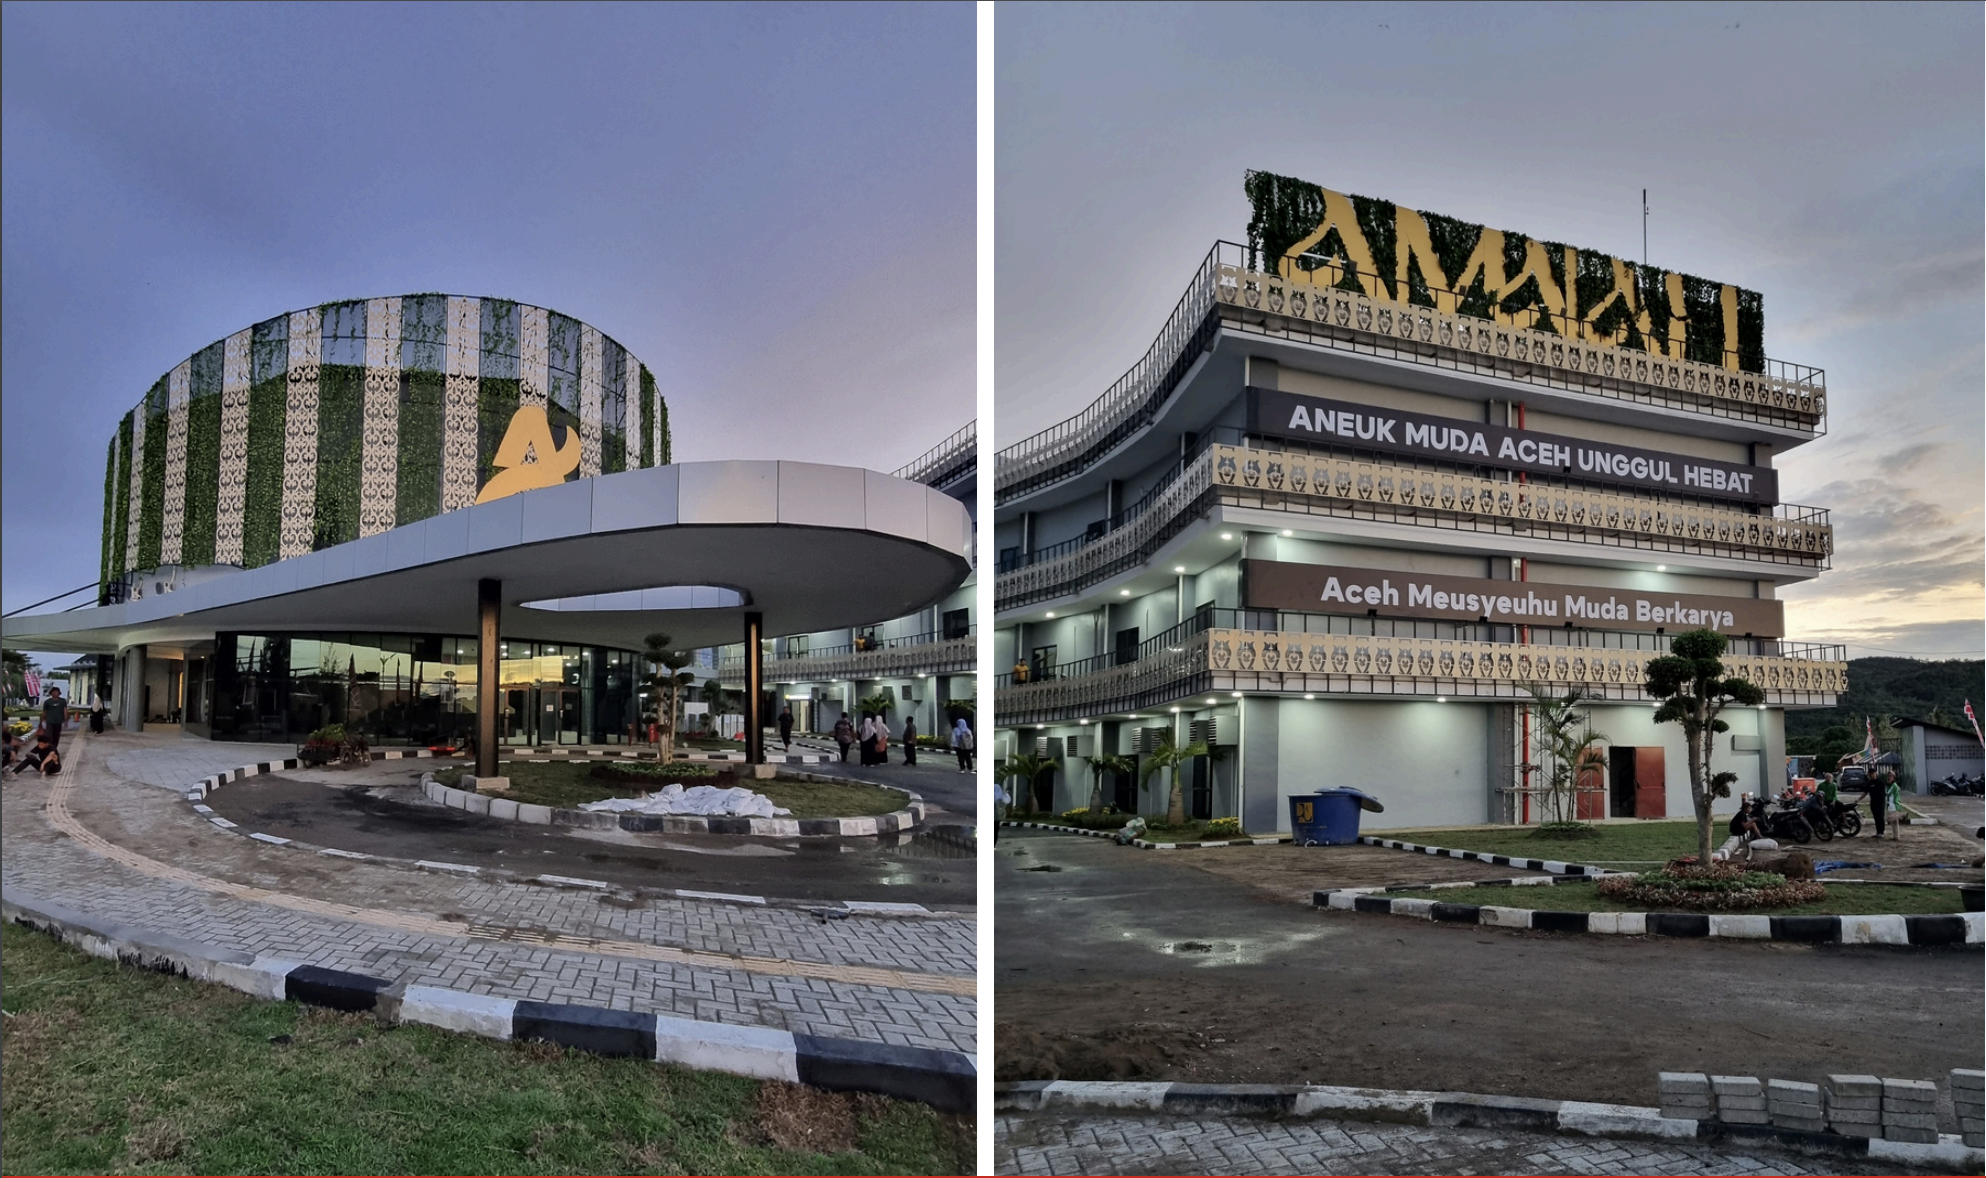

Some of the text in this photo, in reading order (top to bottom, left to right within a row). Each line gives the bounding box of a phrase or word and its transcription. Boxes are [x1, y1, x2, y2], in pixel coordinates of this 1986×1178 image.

[1288, 404, 1754, 494] ANEUK MUDA ACEH UNGGUL HEBAT
[1320, 576, 1734, 631] Aceh Meusyeuhu Muda Berkarya
